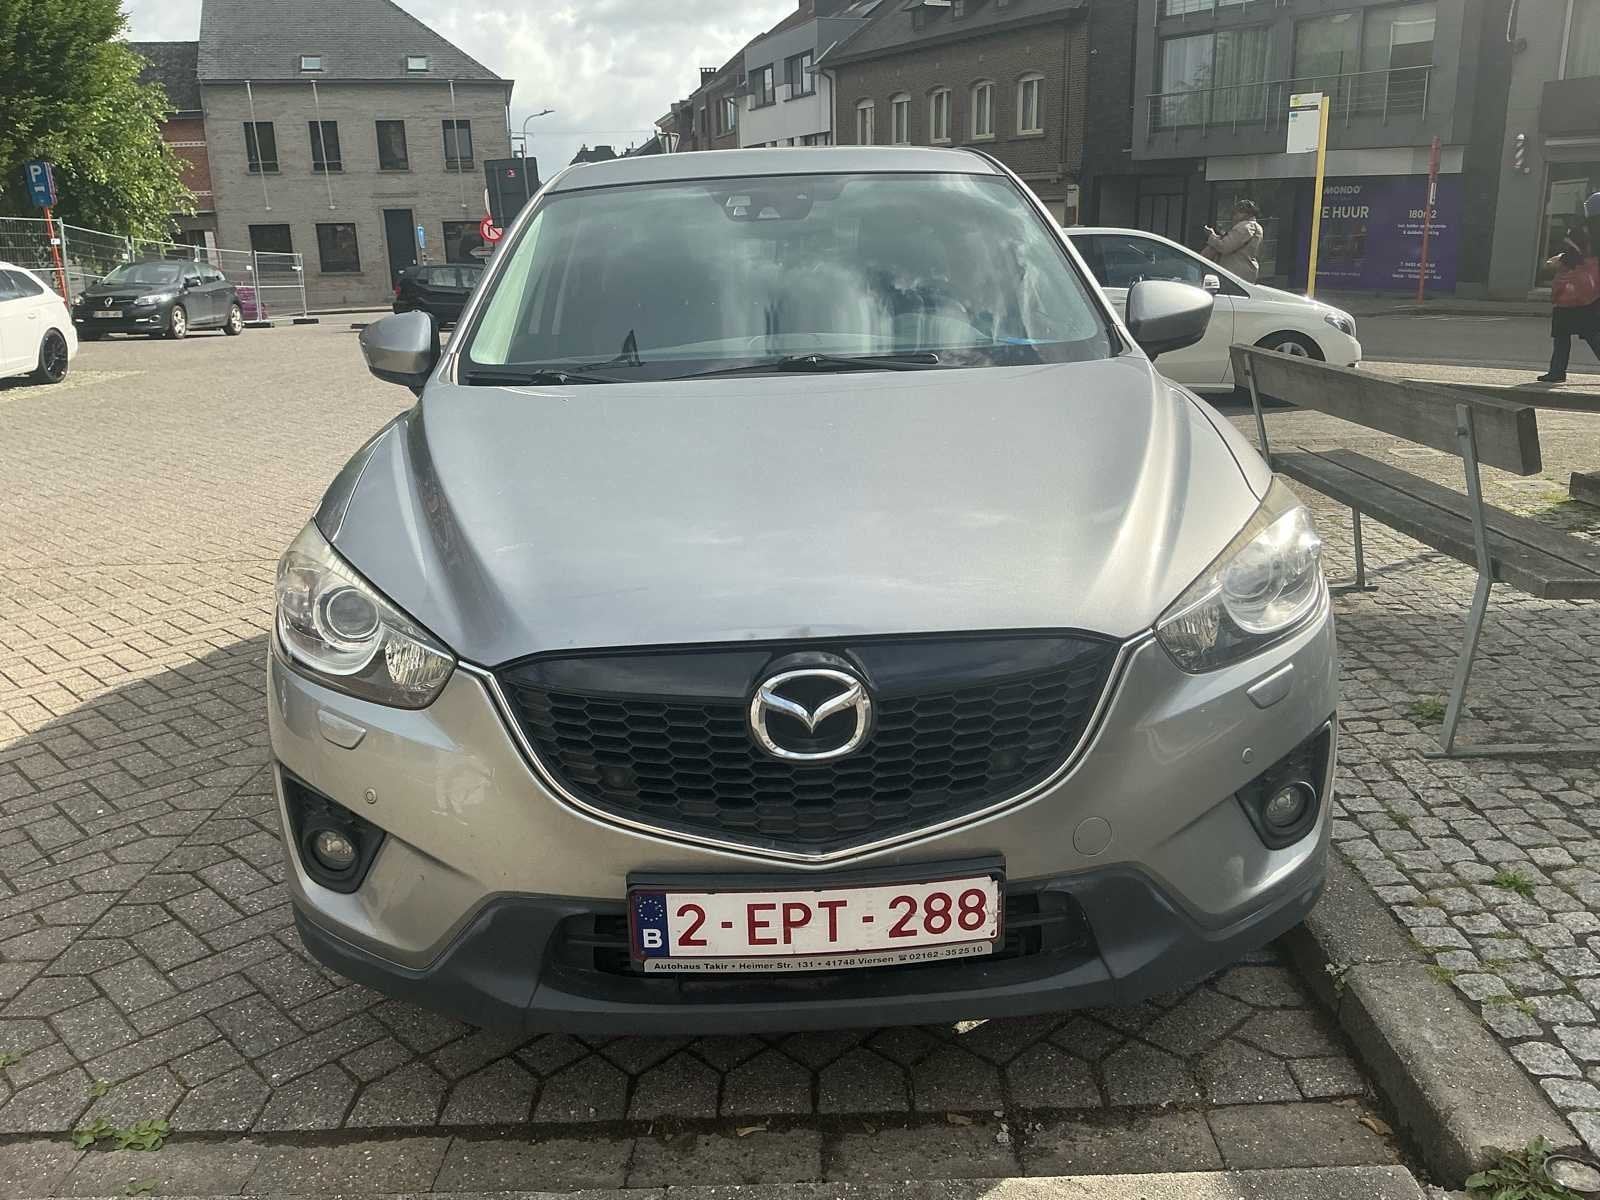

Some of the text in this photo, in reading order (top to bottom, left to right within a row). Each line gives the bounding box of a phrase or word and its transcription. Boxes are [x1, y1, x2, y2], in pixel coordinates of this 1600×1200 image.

[29, 165, 42, 183] P
[1331, 206, 1369, 219] HUUR
[1408, 209, 1437, 219] 1802
[676, 888, 988, 947] 2-EPT-288
[642, 928, 663, 949] B
[653, 962, 700, 970] Autohaus
[703, 962, 729, 970] Takir
[776, 961, 793, 969] Str.
[825, 959, 855, 967] 41748
[858, 956, 894, 965] Viersen
